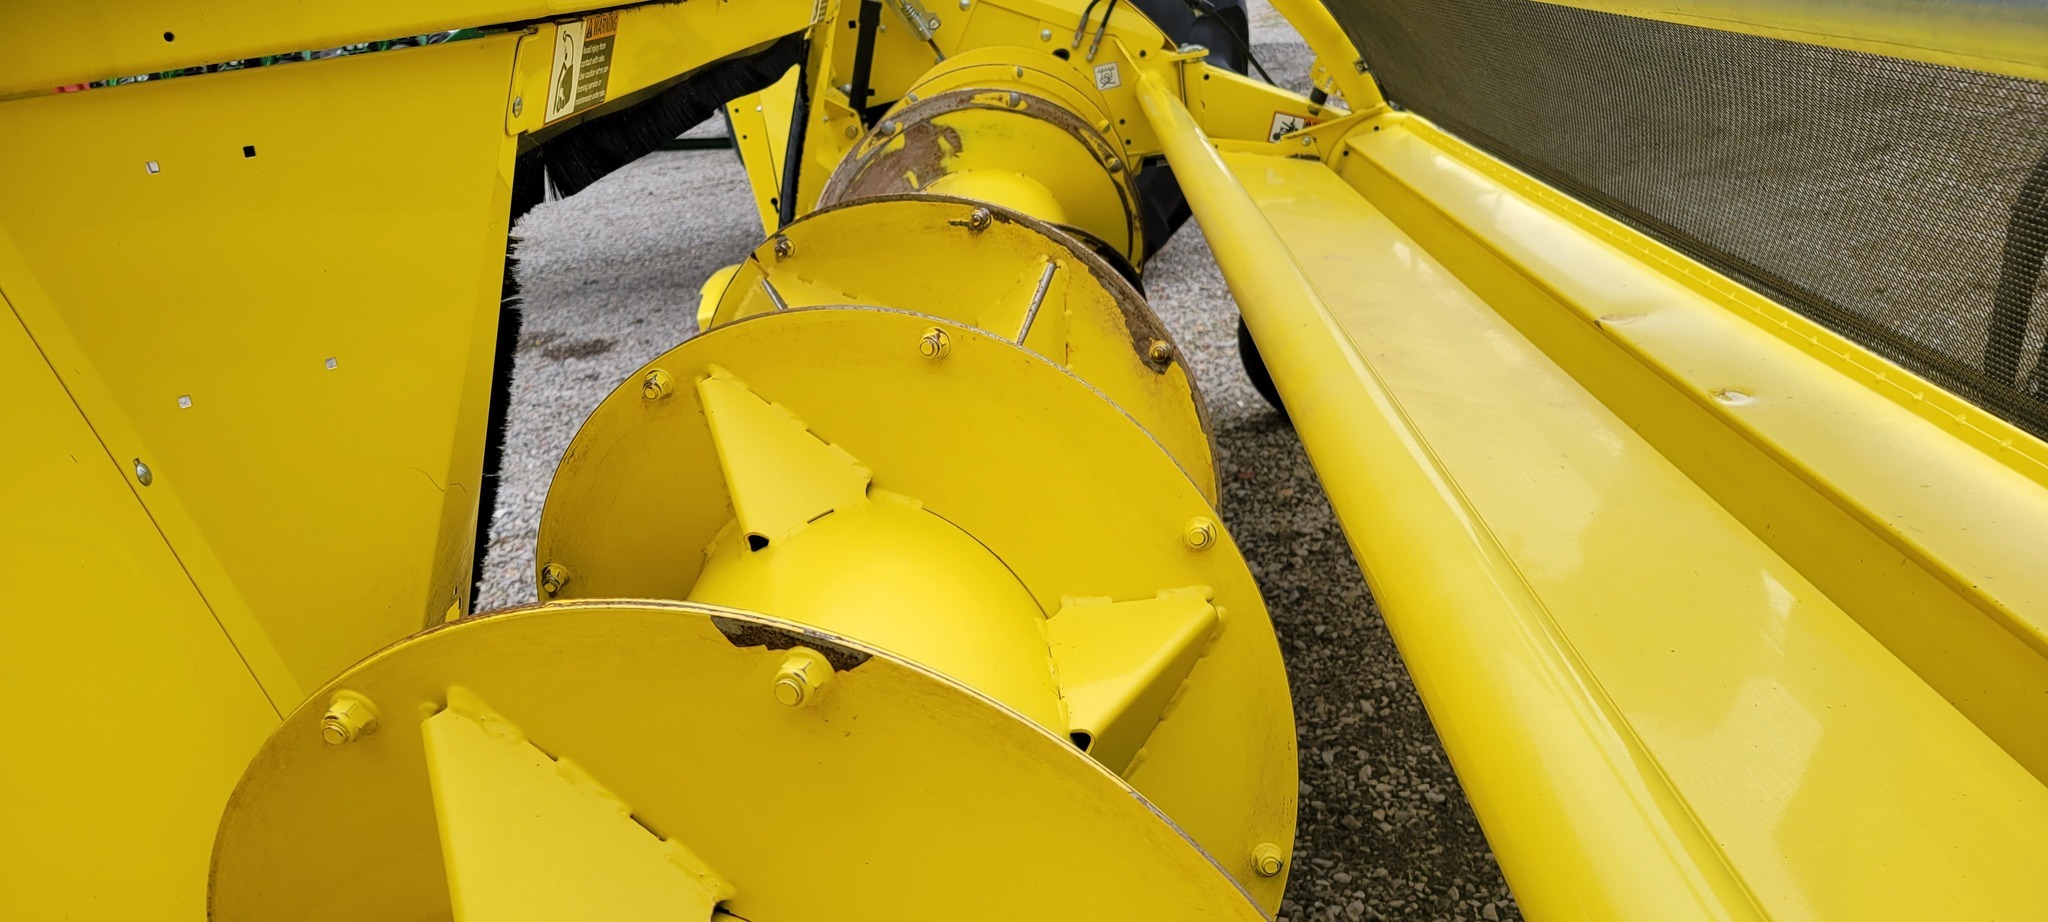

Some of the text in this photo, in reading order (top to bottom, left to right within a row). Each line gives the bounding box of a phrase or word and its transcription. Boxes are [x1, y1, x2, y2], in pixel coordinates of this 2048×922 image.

[593, 14, 618, 36] WARNING
[581, 58, 592, 67] contact
[585, 69, 596, 78] caution
[588, 81, 598, 89] service
[575, 95, 592, 105] maintenance
